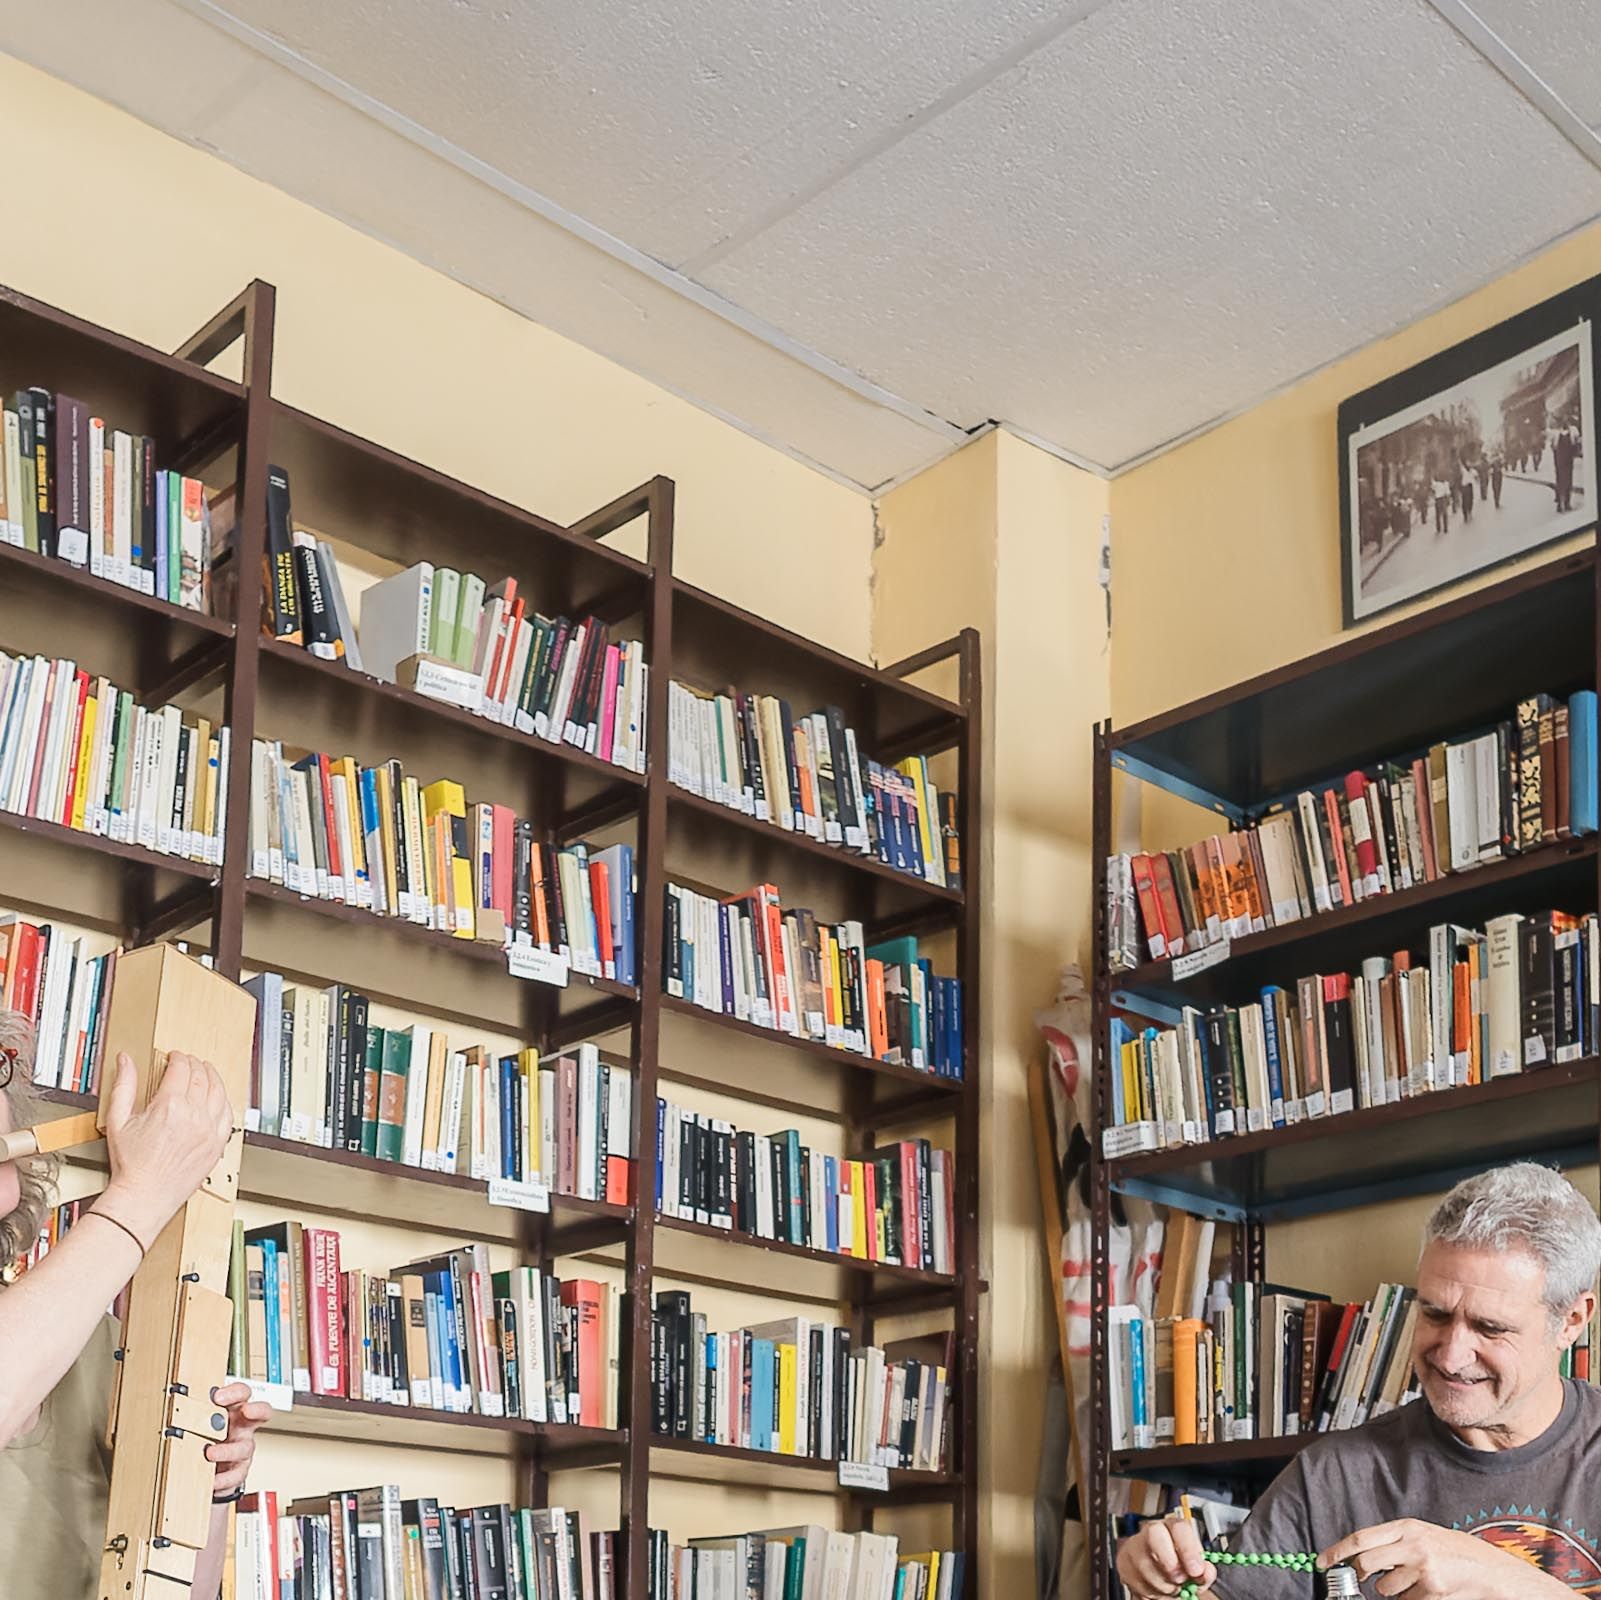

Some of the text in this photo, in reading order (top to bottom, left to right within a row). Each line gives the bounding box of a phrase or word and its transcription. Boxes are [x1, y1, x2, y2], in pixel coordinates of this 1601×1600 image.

[278, 568, 288, 600] DANZA
[287, 601, 296, 615] LOS
[315, 1233, 327, 1286] FRANK BAER
[325, 1236, 341, 1366] EL PUENTE DE ALCANTARA
